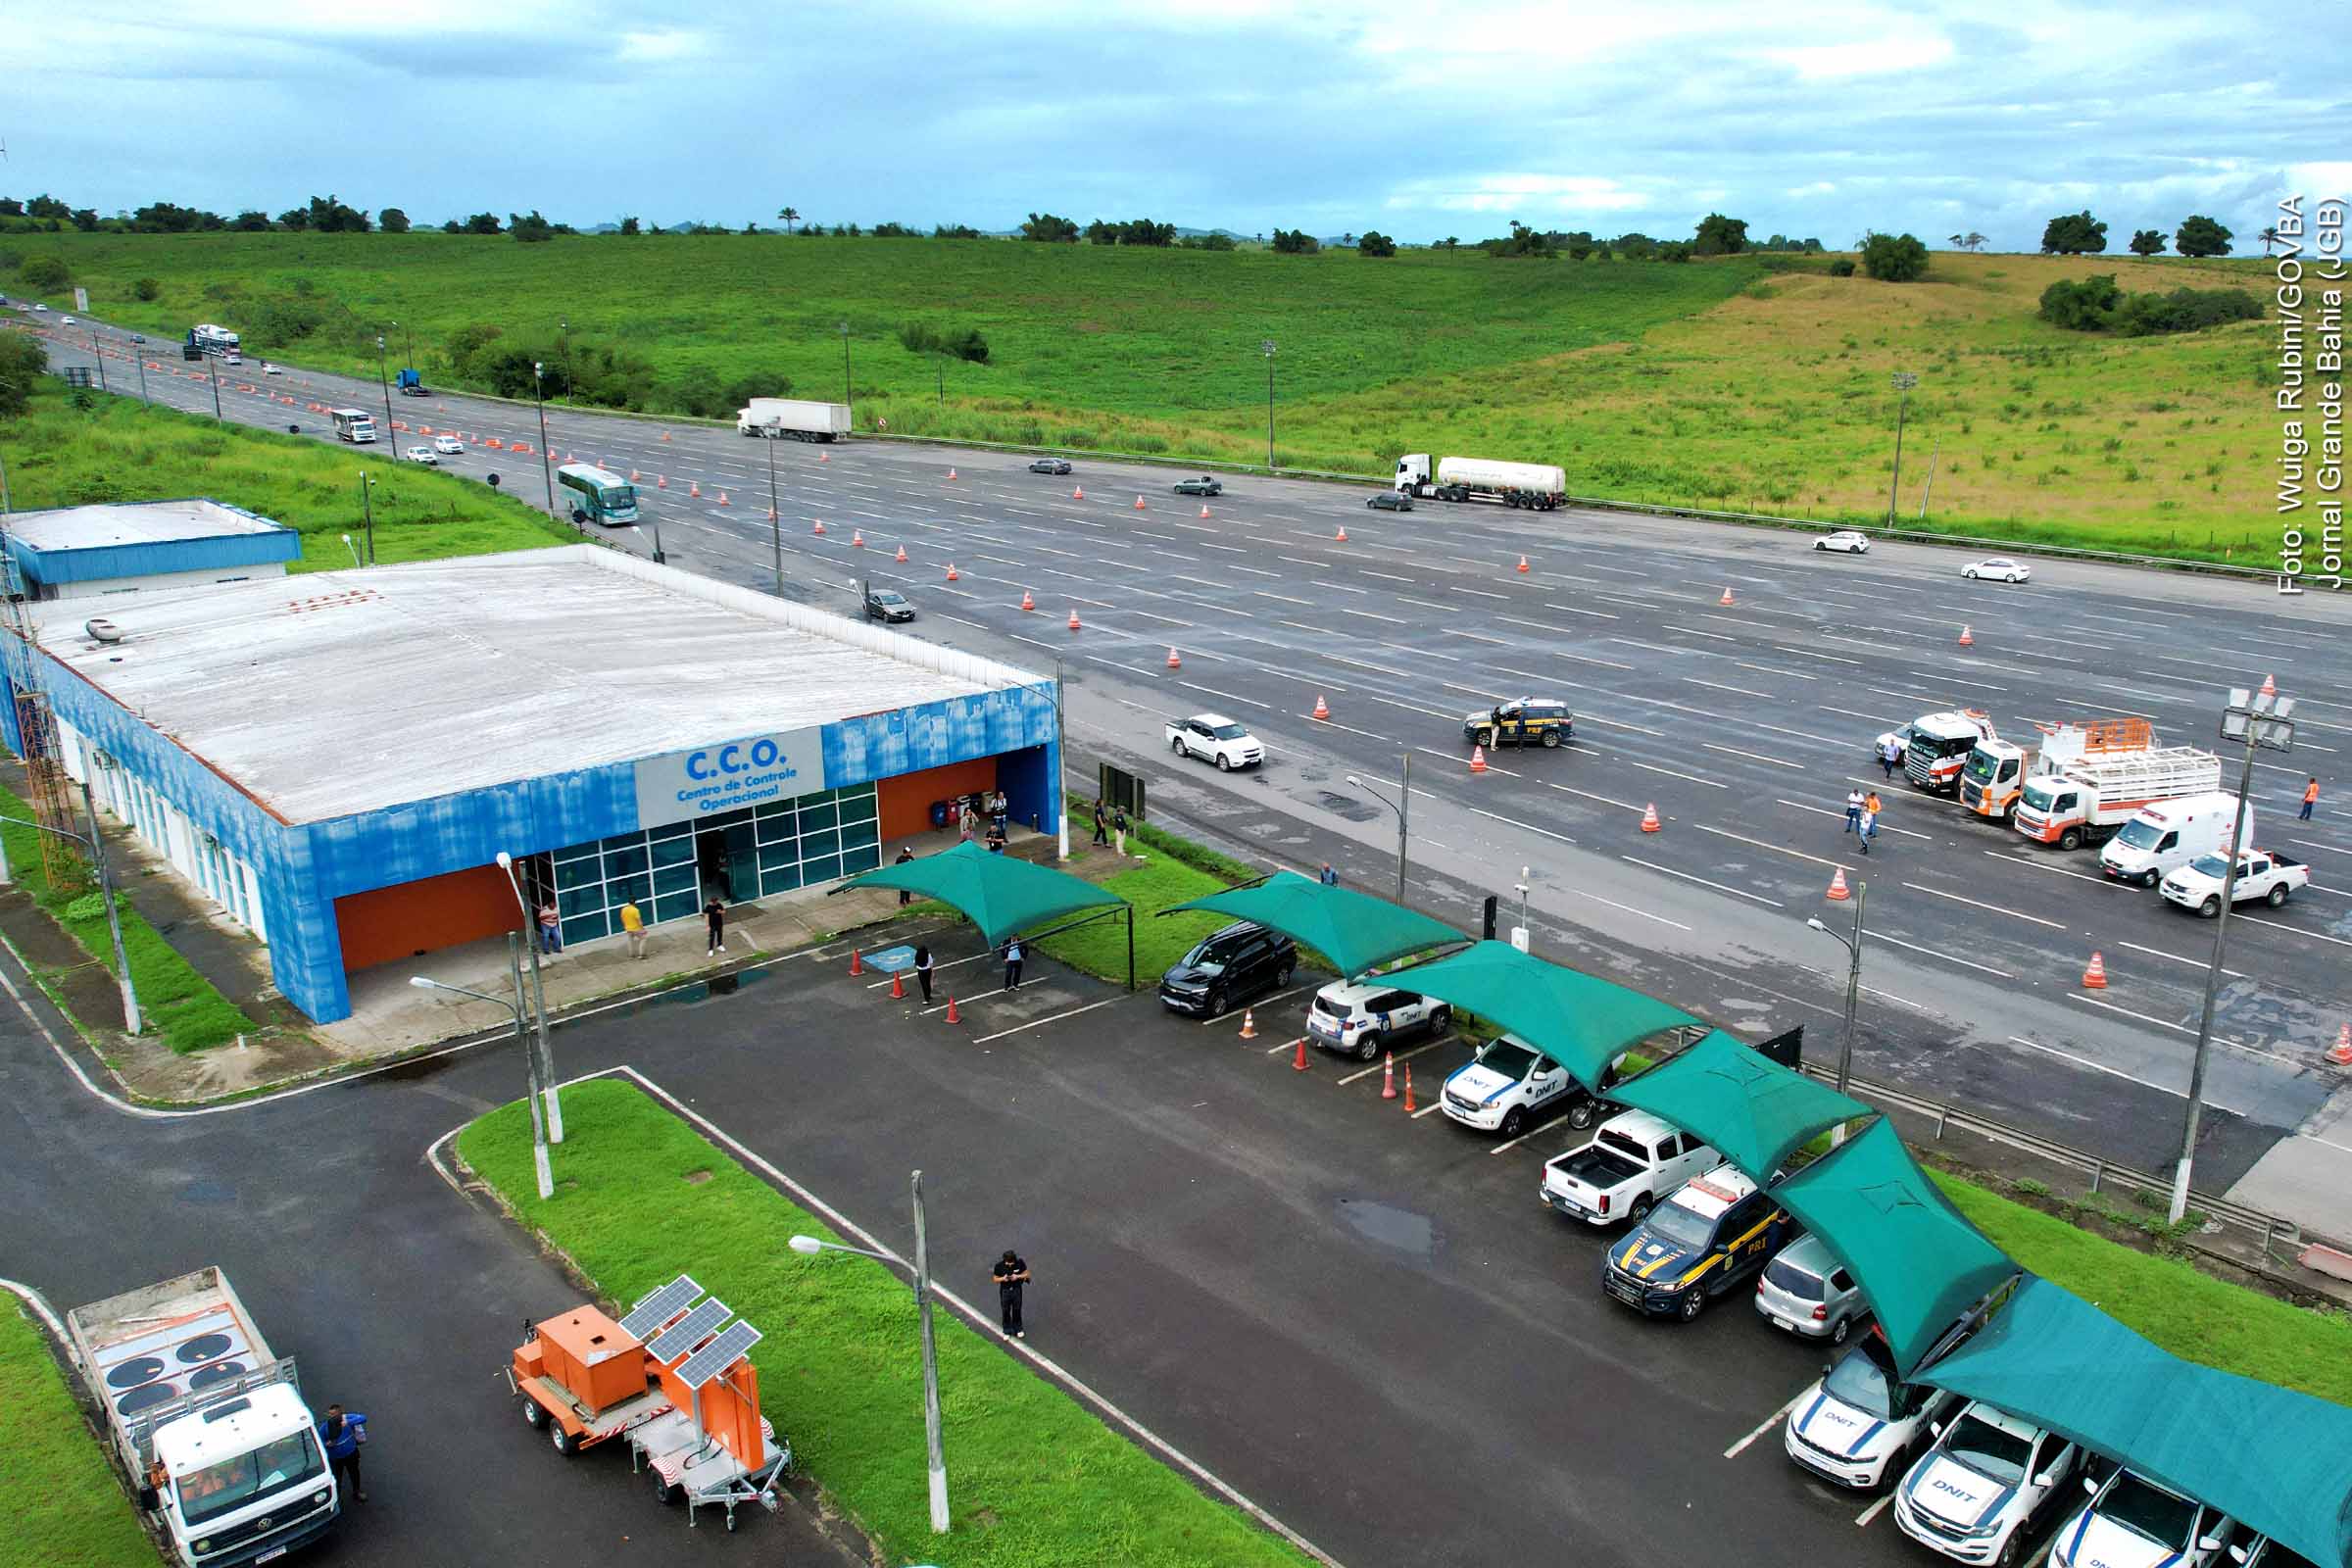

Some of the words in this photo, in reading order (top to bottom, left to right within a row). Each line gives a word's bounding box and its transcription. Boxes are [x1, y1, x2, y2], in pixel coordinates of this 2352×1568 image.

[686, 739, 788, 781] C.C.O.
[676, 785, 721, 802] Centro
[723, 780, 741, 792] de
[745, 767, 798, 787] Controle
[699, 783, 779, 811] Operacional
[1535, 1080, 1558, 1099] DNIT
[1824, 1411, 1858, 1428] DNIT
[1932, 1480, 1978, 1503] DNIT
